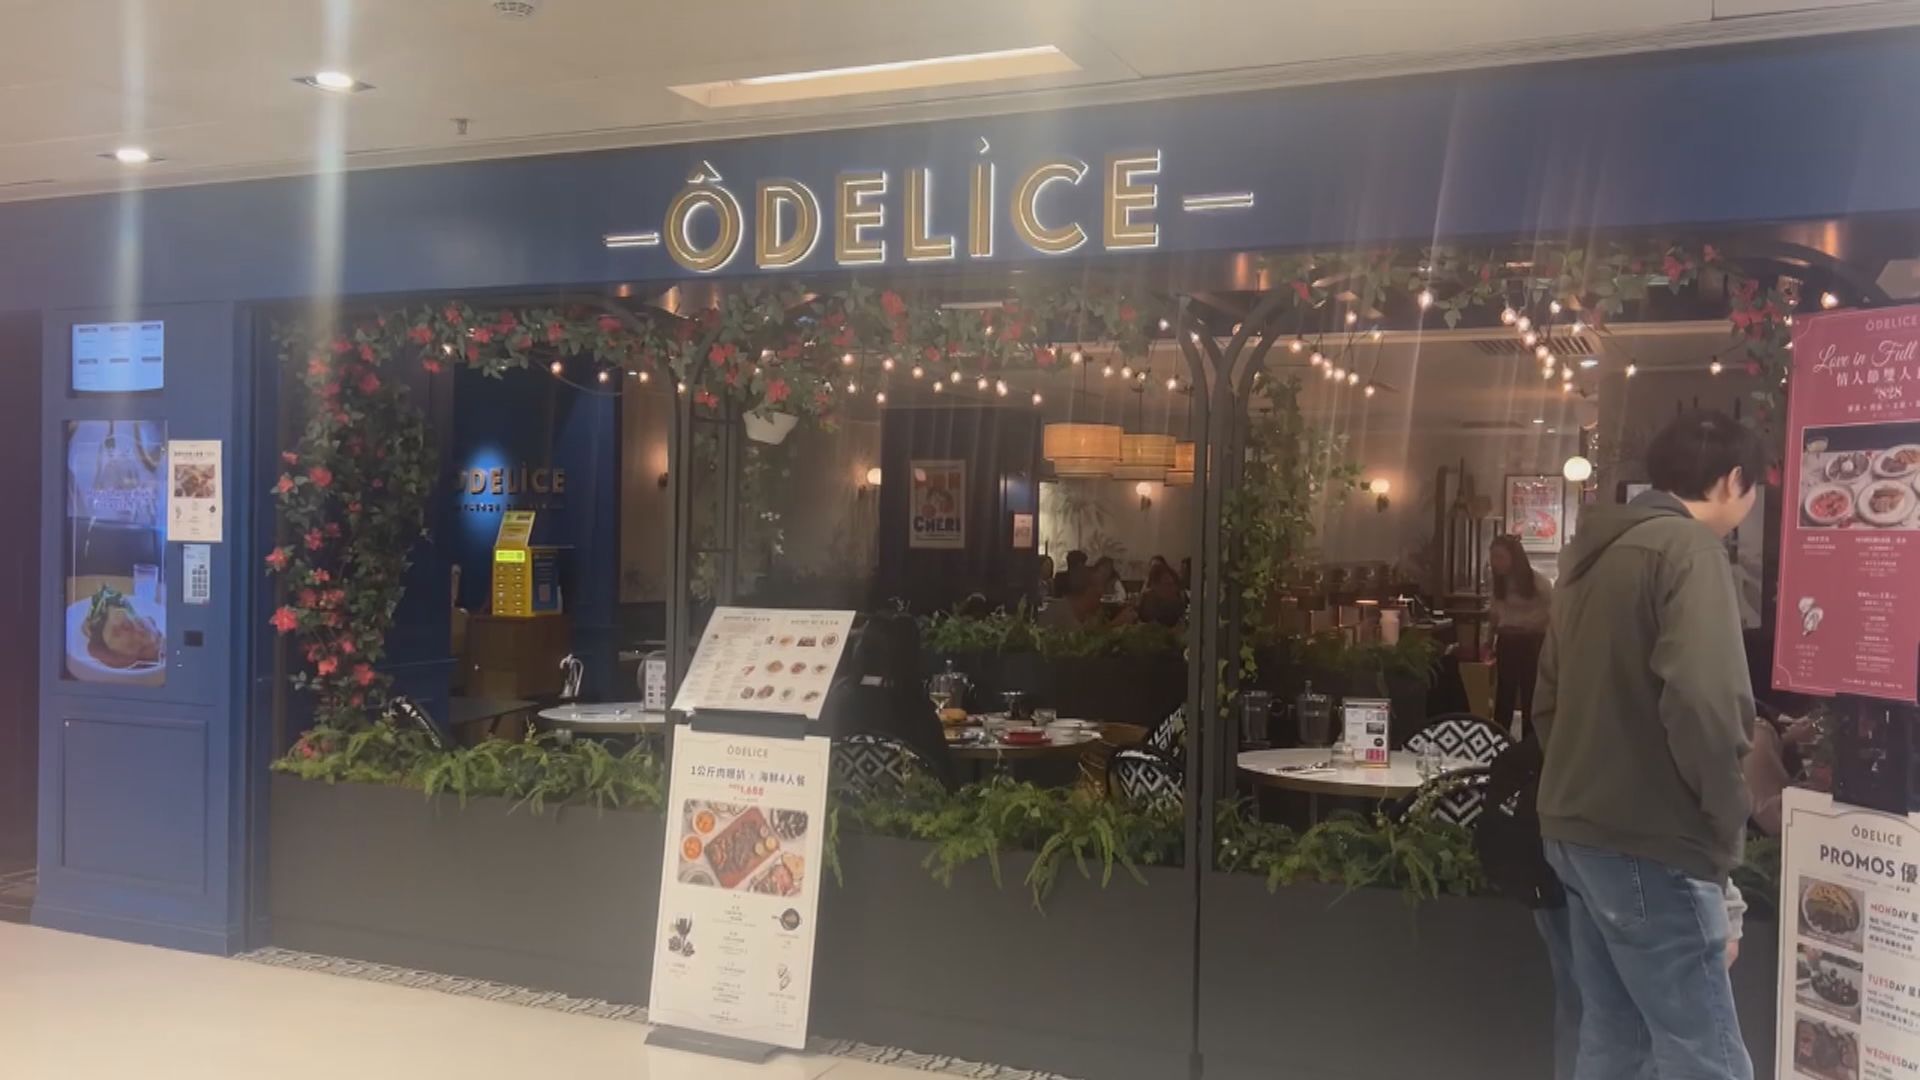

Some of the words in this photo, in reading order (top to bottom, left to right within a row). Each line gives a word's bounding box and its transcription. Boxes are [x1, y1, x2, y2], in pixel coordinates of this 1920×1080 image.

[1812, 343, 1849, 375] Love
[1853, 351, 1866, 366] in
[1871, 340, 1918, 367] Full
[1851, 824, 1902, 847] ÔDELICE
[1820, 844, 1895, 877] PROMOS
[1870, 904, 1909, 919] MONDAY
[1868, 975, 1906, 993] TUESDAY
[1865, 1046, 1919, 1072] WEDNESDAY
